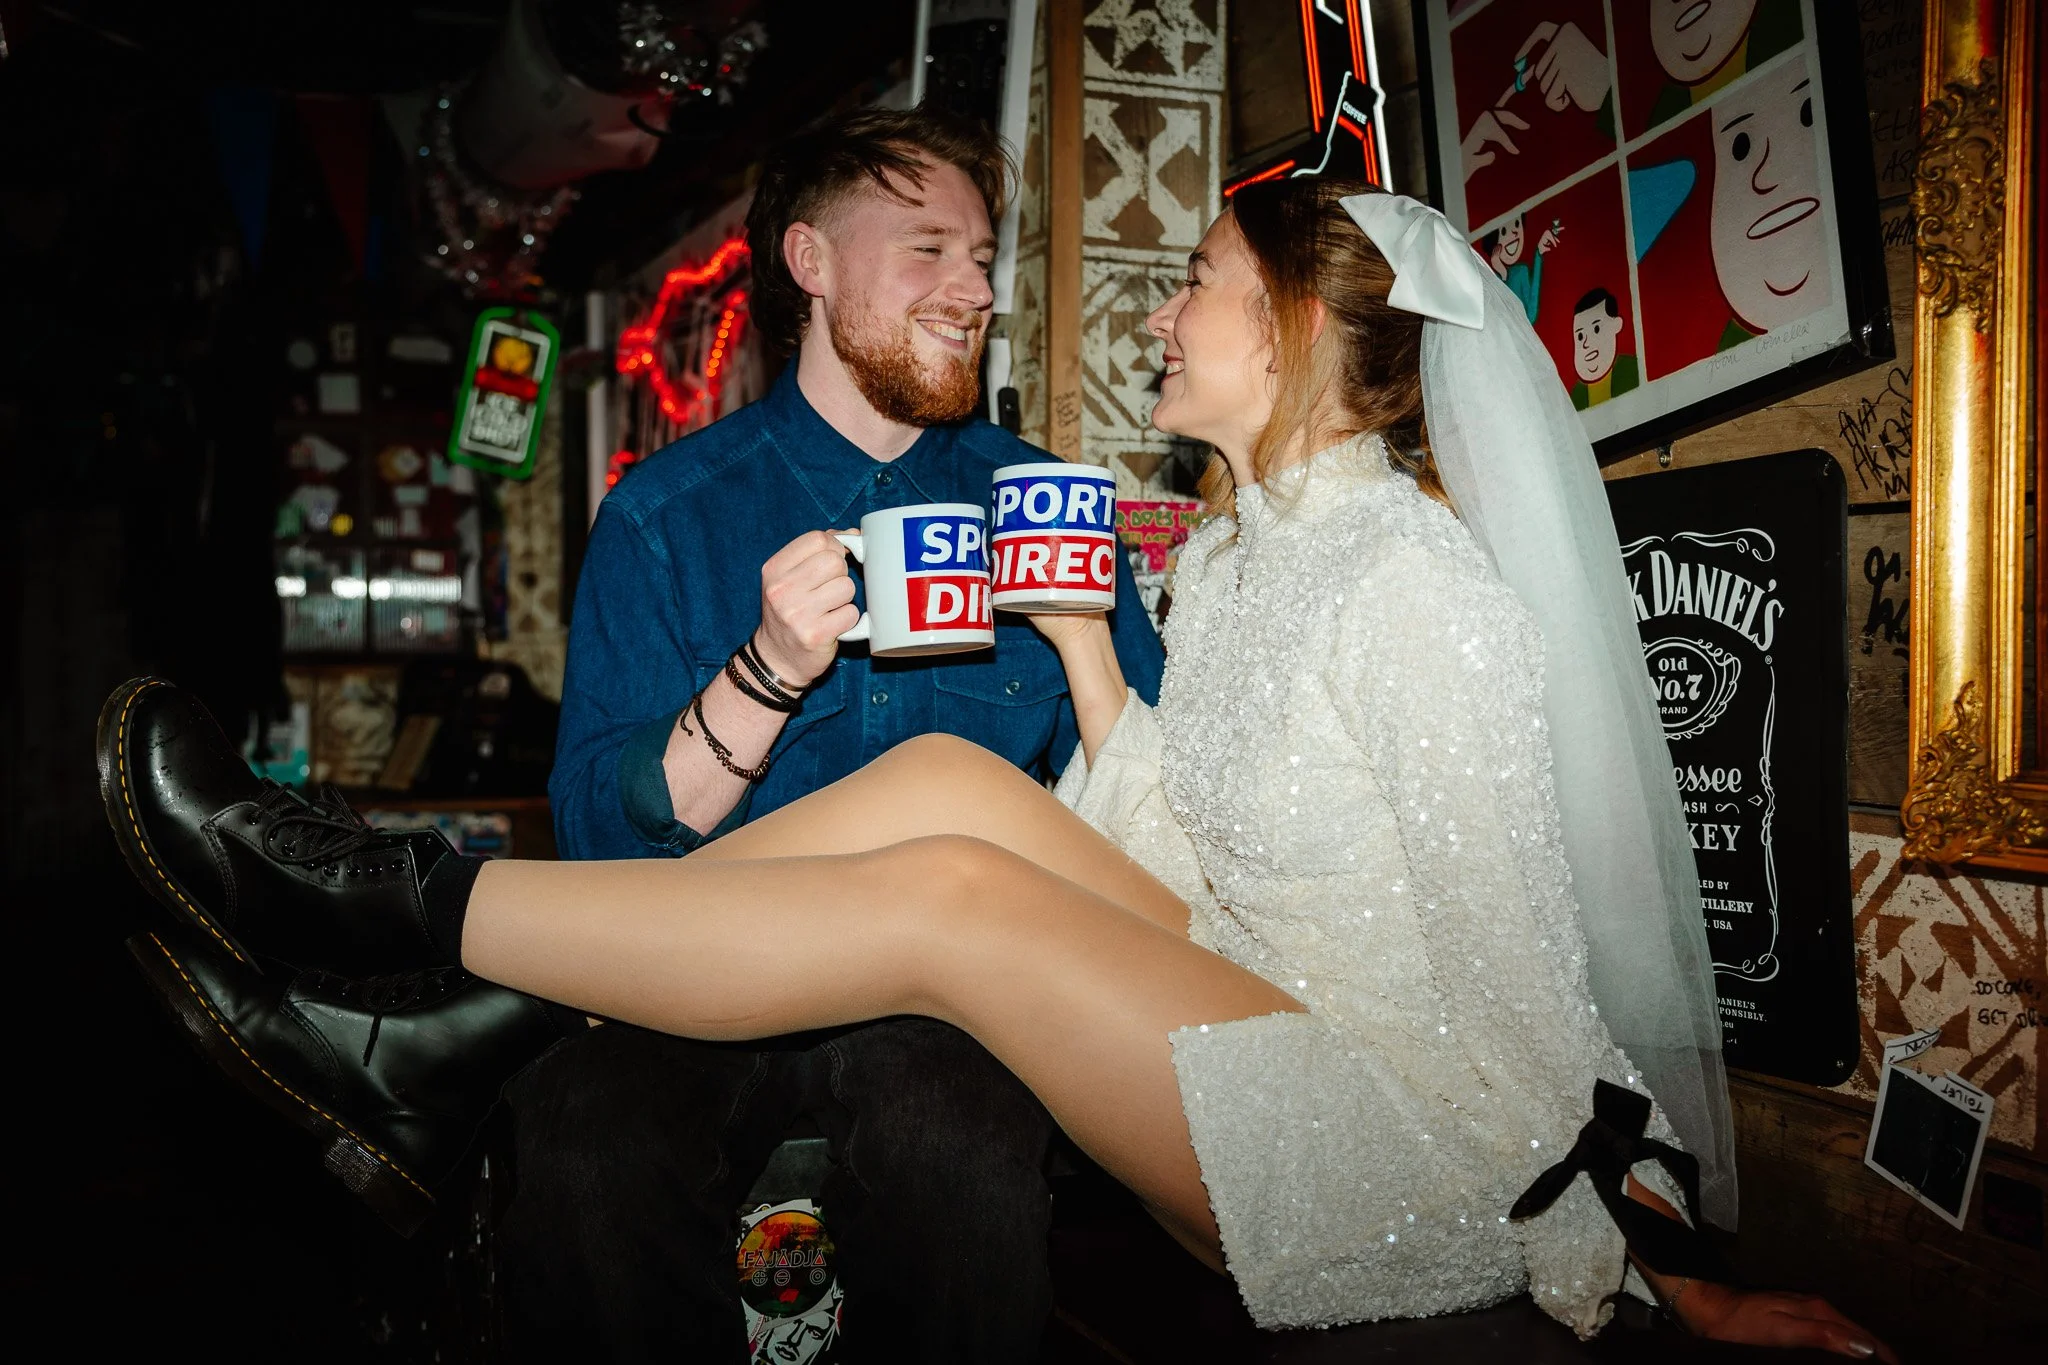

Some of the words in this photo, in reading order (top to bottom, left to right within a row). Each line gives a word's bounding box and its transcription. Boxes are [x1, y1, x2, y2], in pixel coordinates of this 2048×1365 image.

[1650, 550, 1785, 651] DANIEL'S
[1717, 881, 1729, 890] BY
[1712, 919, 1733, 930] USA
[1977, 1008, 2008, 1026] GET
[1940, 1083, 1985, 1113] TOILET
